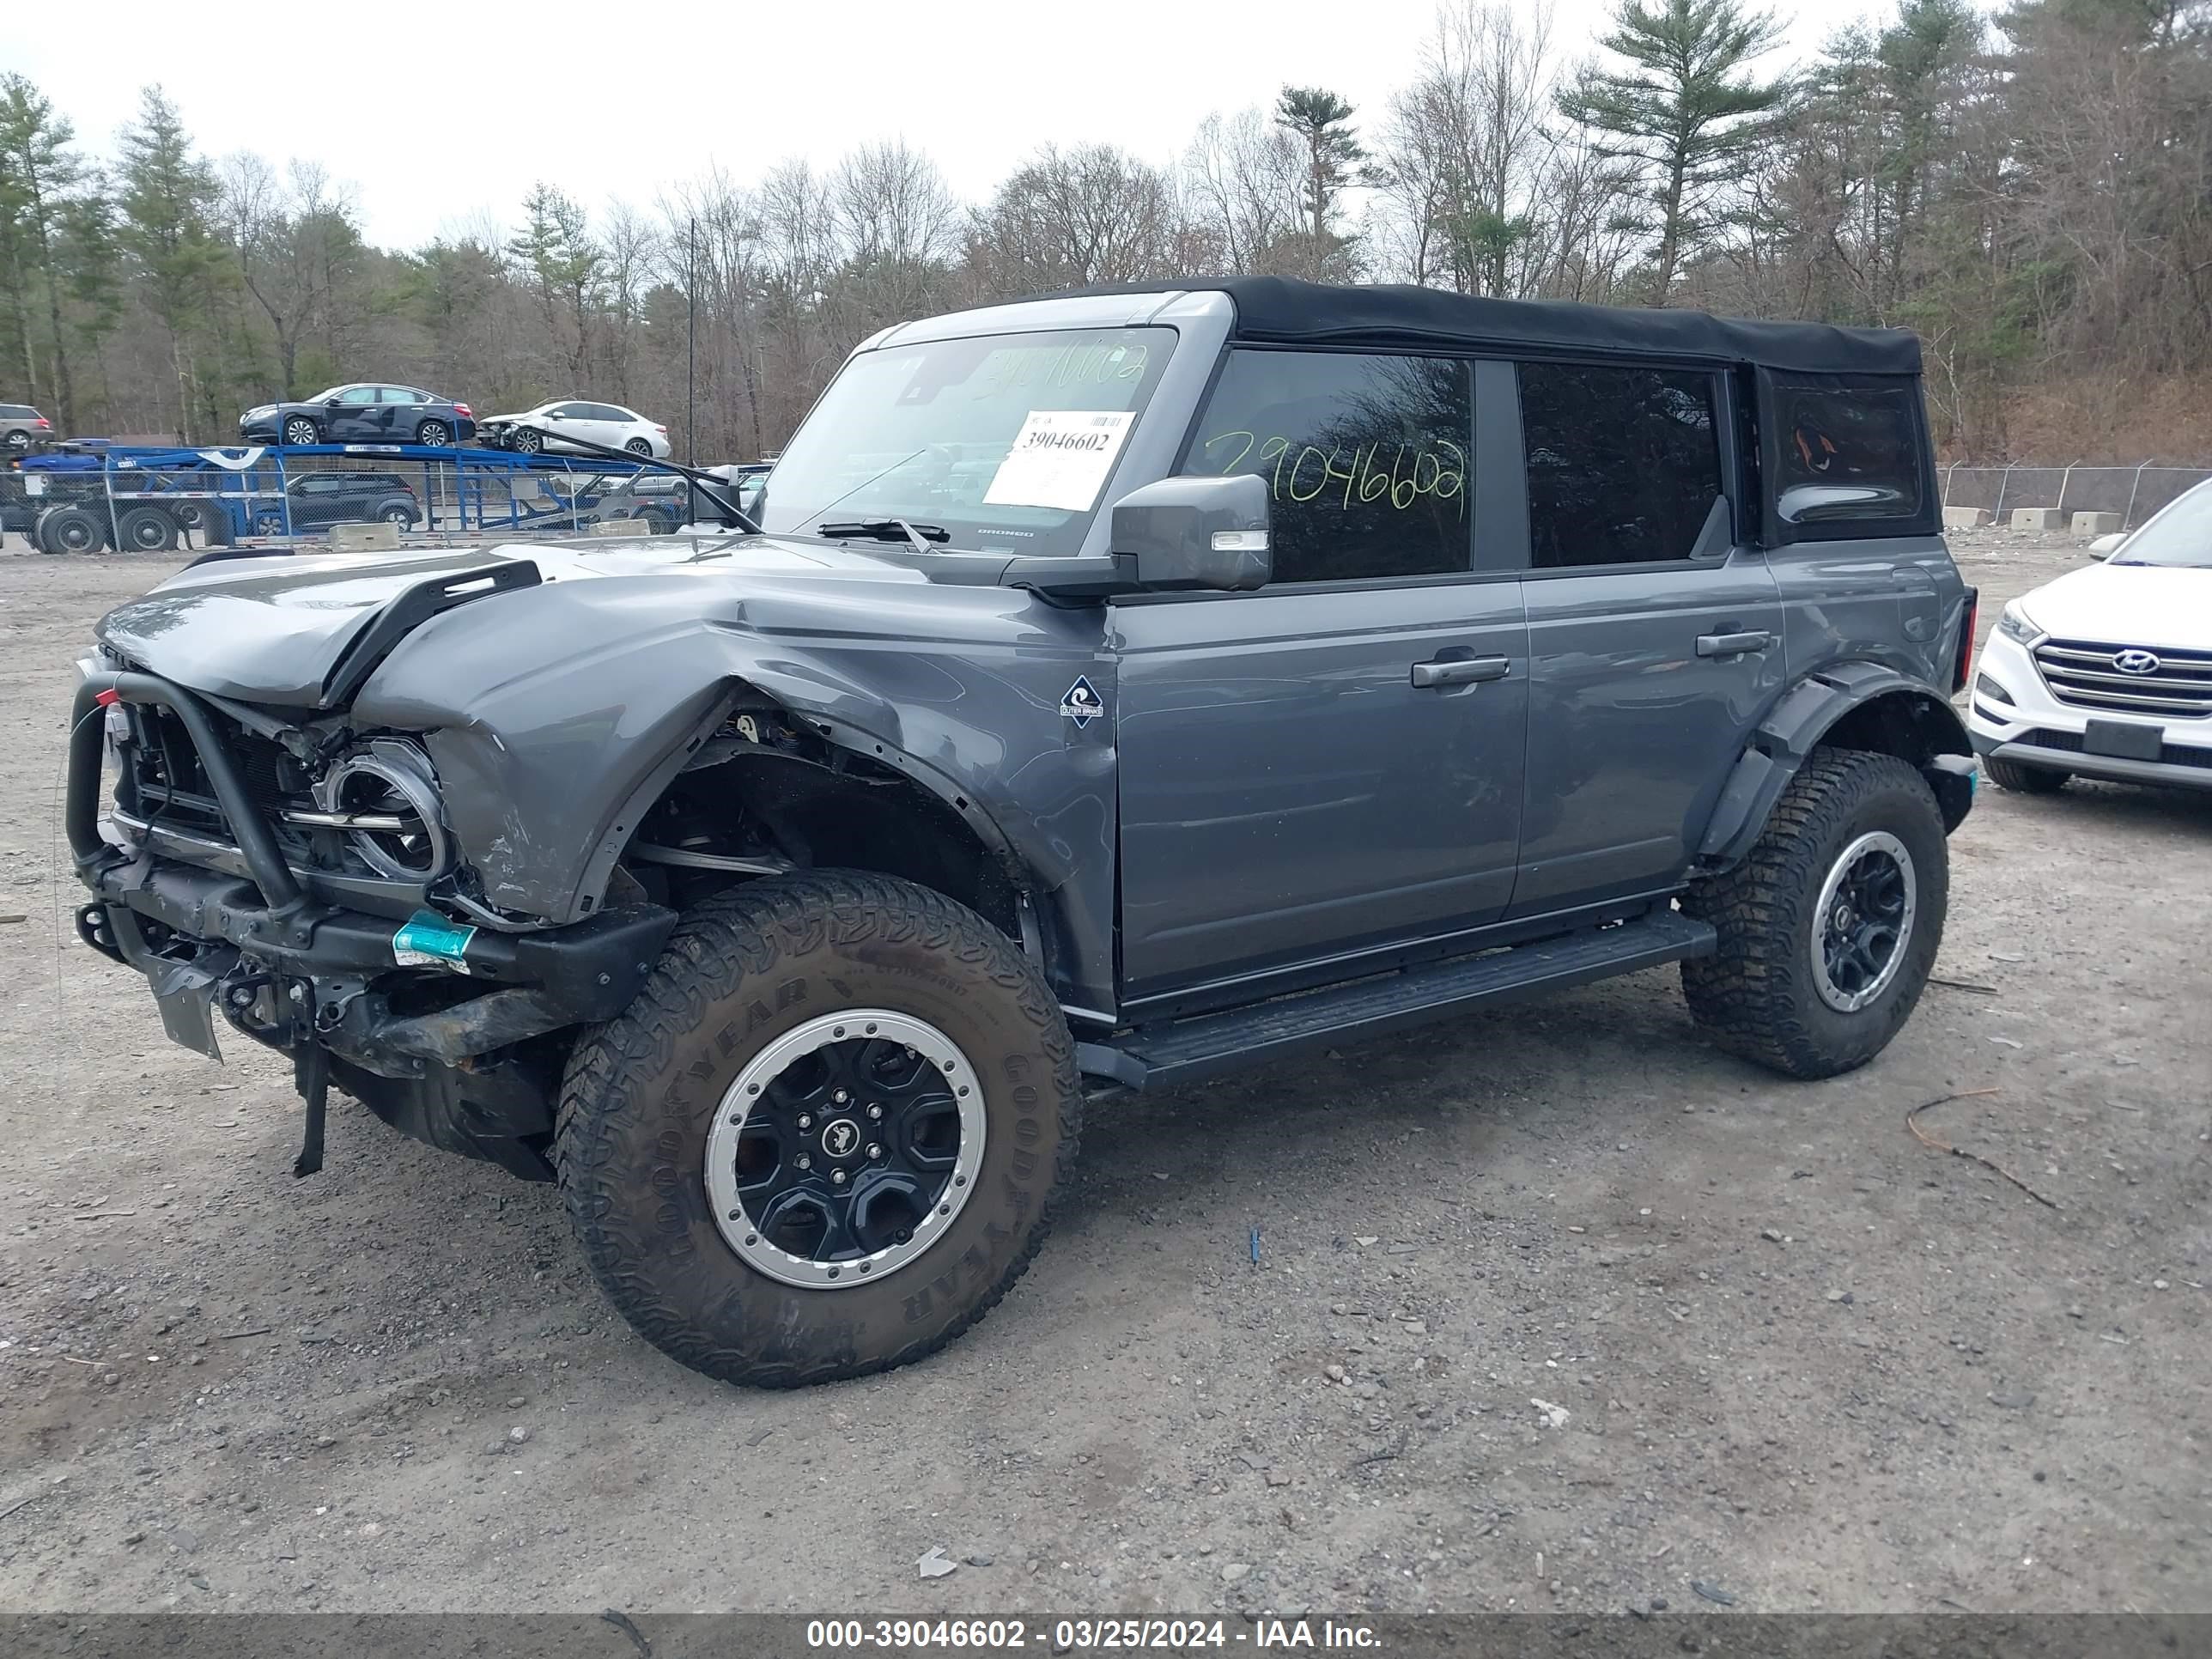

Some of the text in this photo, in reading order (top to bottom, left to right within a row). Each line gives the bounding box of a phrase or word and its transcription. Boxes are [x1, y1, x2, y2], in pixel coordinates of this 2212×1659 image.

[1023, 431, 1109, 452] 39046602
[652, 976, 808, 1266] GOODYEAR
[901, 1053, 1041, 1323] GOODYEAR
